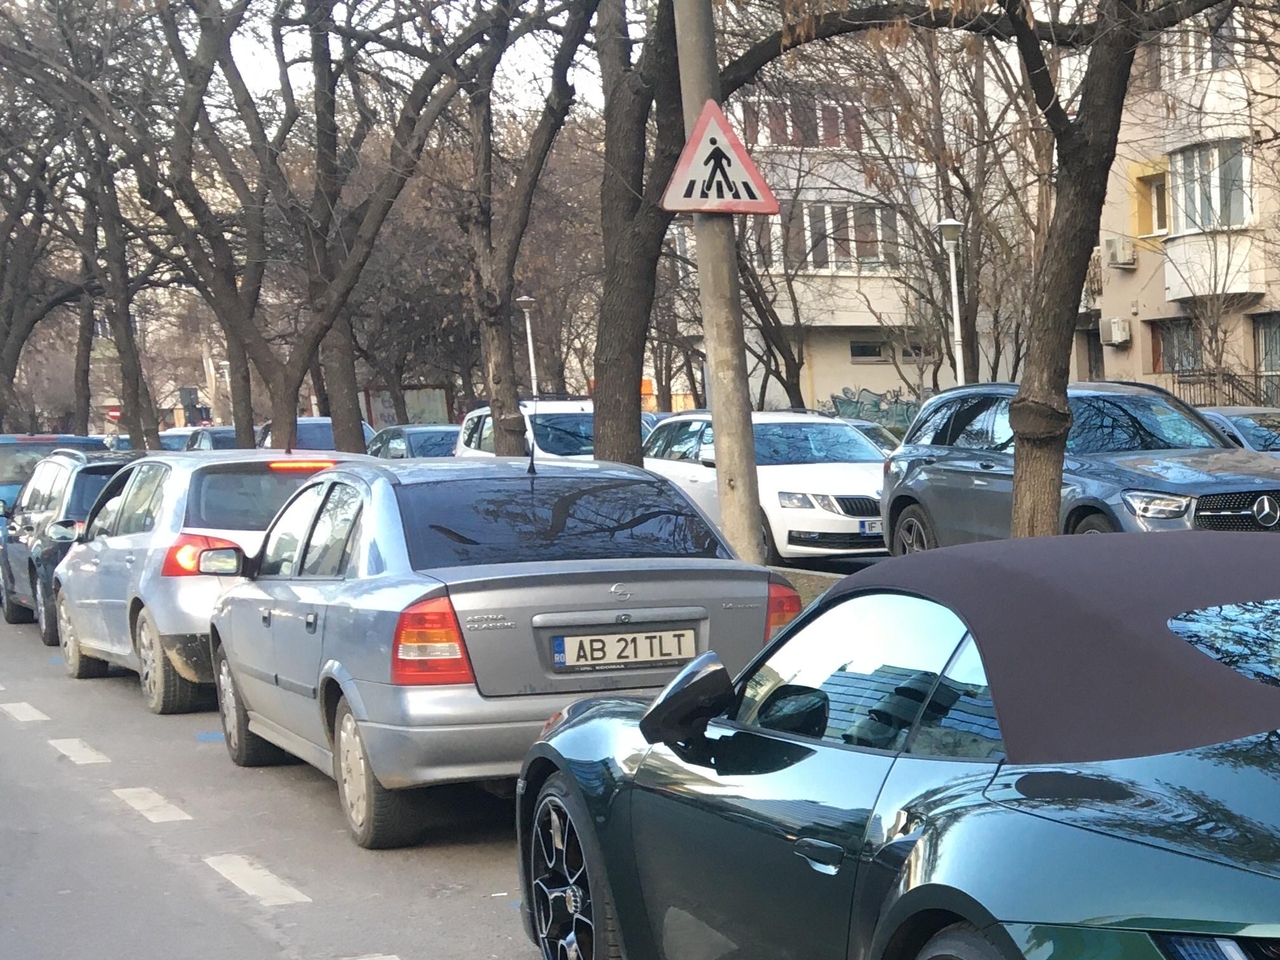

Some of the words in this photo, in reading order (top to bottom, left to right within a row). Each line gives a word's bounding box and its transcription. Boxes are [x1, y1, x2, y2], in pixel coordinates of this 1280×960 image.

[868, 522, 876, 531] IF
[467, 614, 506, 622] ASTRA
[467, 621, 517, 631] CLASSIC
[576, 639, 606, 662] AB
[616, 637, 638, 659] 21
[644, 634, 685, 657] TLT
[554, 653, 565, 662] RO
